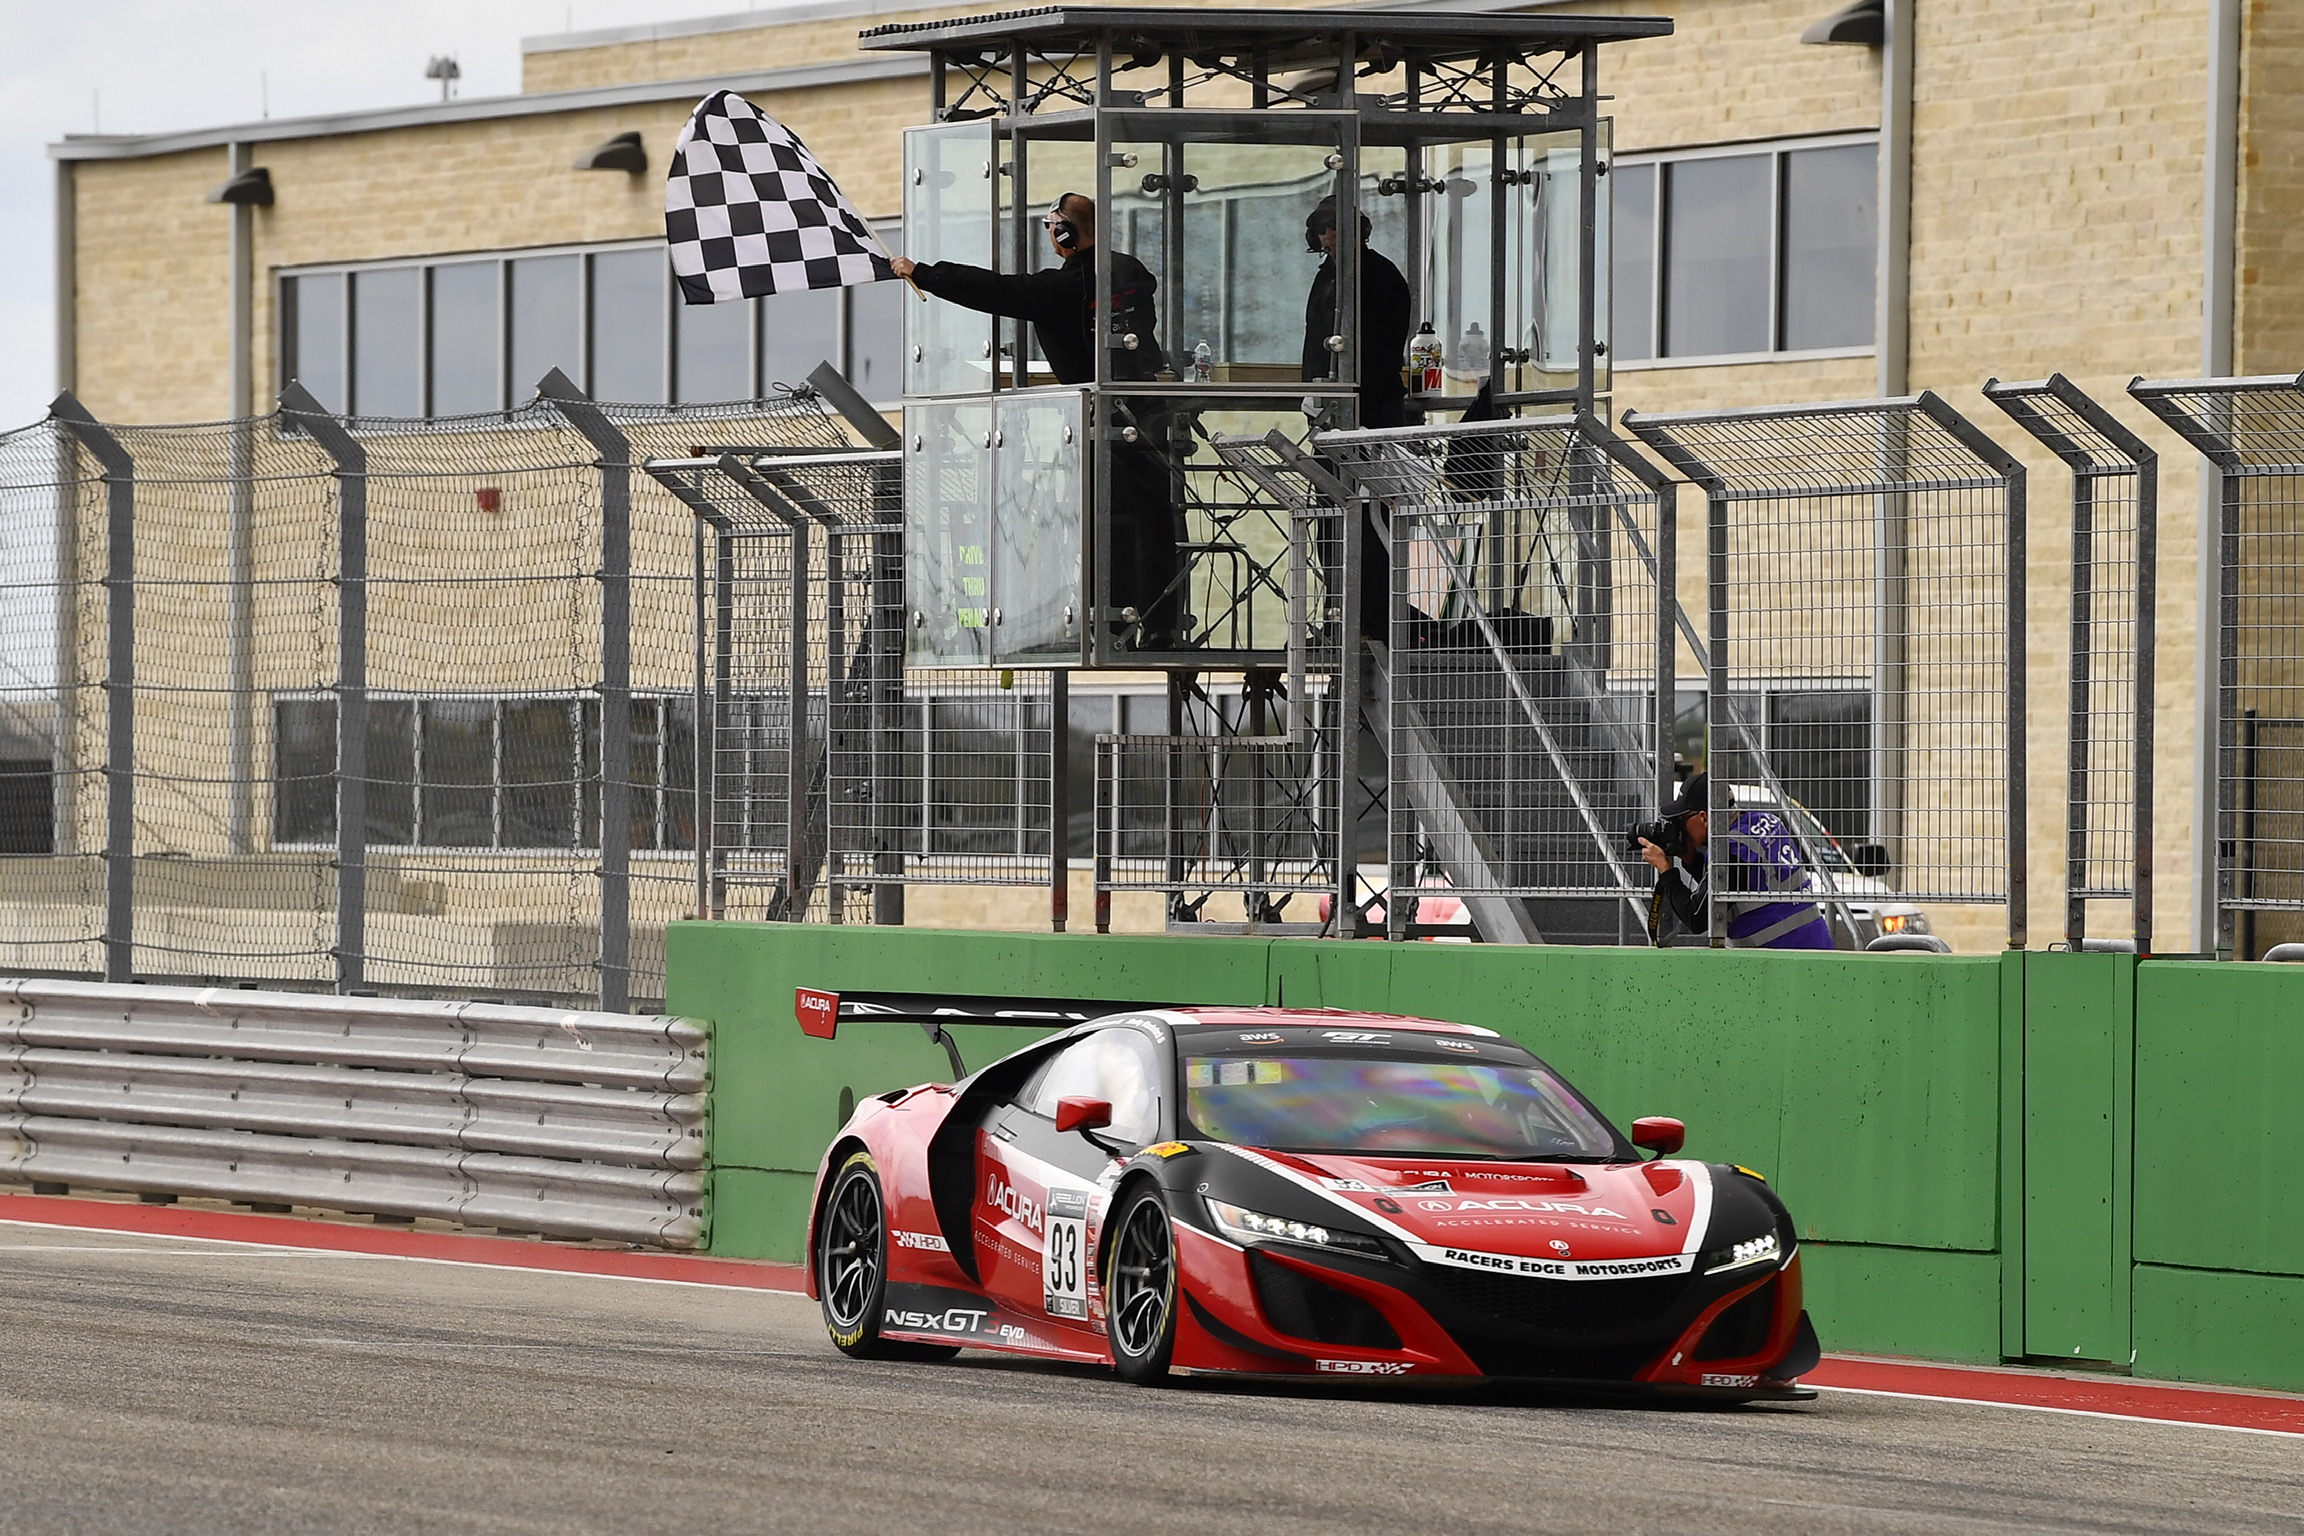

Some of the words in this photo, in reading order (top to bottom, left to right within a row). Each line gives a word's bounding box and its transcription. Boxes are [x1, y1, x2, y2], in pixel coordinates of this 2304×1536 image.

[959, 545, 984, 564] DRIVE
[962, 577, 985, 596] THRU
[806, 996, 831, 1012] ACURA
[1239, 1031, 1281, 1042] aws
[1435, 1039, 1475, 1049] aws
[1333, 1178, 1366, 1190] 93
[994, 1181, 1043, 1234] ACURA
[1457, 1200, 1627, 1220] ACURA
[1437, 1218, 1559, 1227] ACCELERATED
[1569, 1221, 1643, 1235] SERVICE
[919, 1235, 942, 1249] HPD
[974, 1230, 1011, 1260] ACCELERATED
[1014, 1252, 1040, 1275] SERVICE
[1051, 1222, 1077, 1292] 93
[1444, 1249, 1514, 1270] RACERS
[1519, 1261, 1566, 1275] EDGE
[1576, 1257, 1683, 1276] MOTORSPORTS
[828, 1322, 864, 1347] PIRELLI
[1000, 1324, 1025, 1340] EVO
[1316, 1361, 1363, 1372] HPD
[1702, 1375, 1732, 1386] HPD
